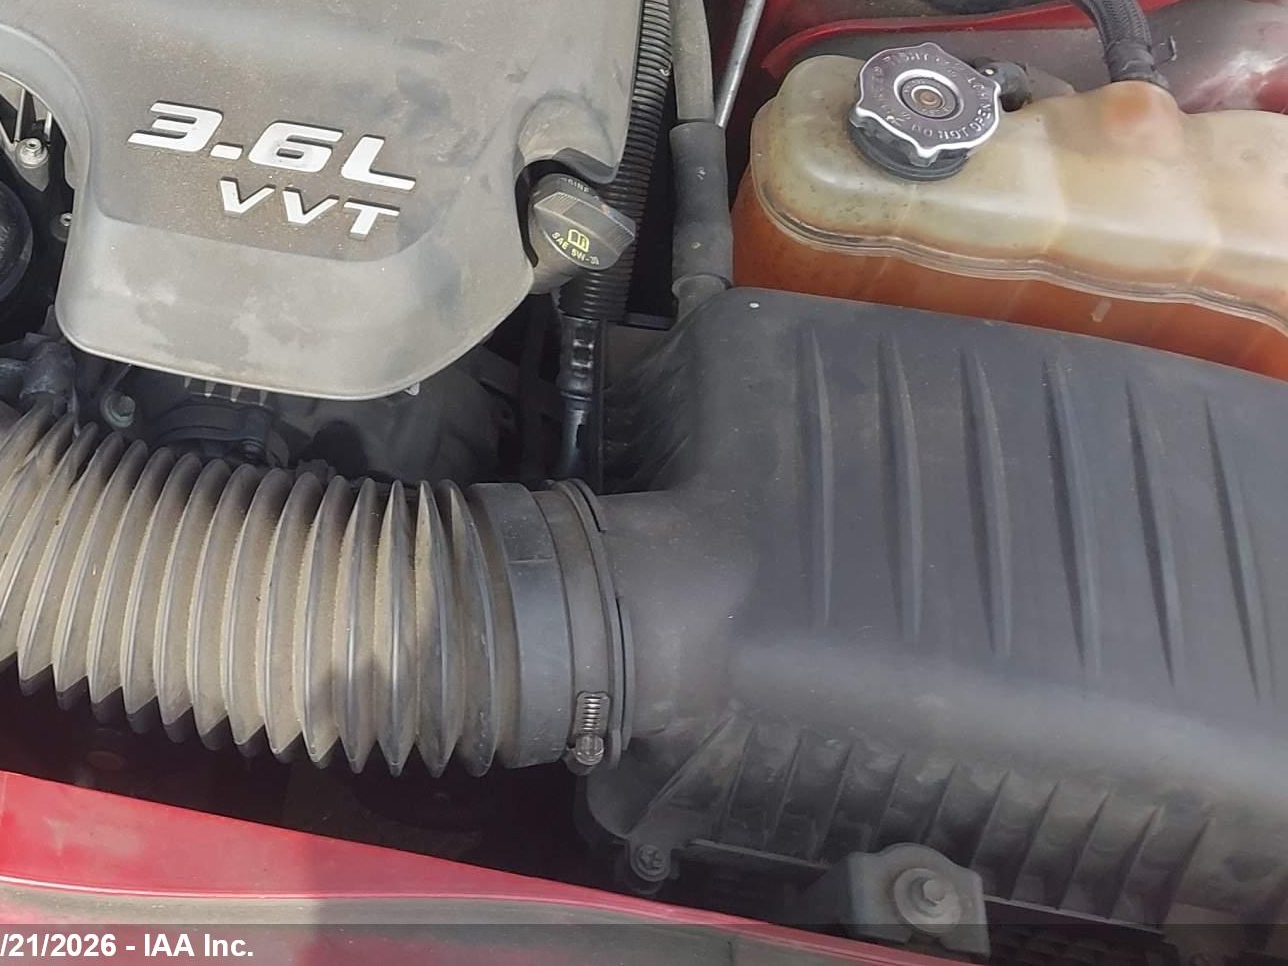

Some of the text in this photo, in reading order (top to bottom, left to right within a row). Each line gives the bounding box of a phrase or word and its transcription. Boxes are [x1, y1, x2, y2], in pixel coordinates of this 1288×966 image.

[127, 101, 417, 192] 3.6L
[937, 126, 969, 141] NOT
[219, 177, 401, 241] VVT
[551, 231, 569, 250] SAE
